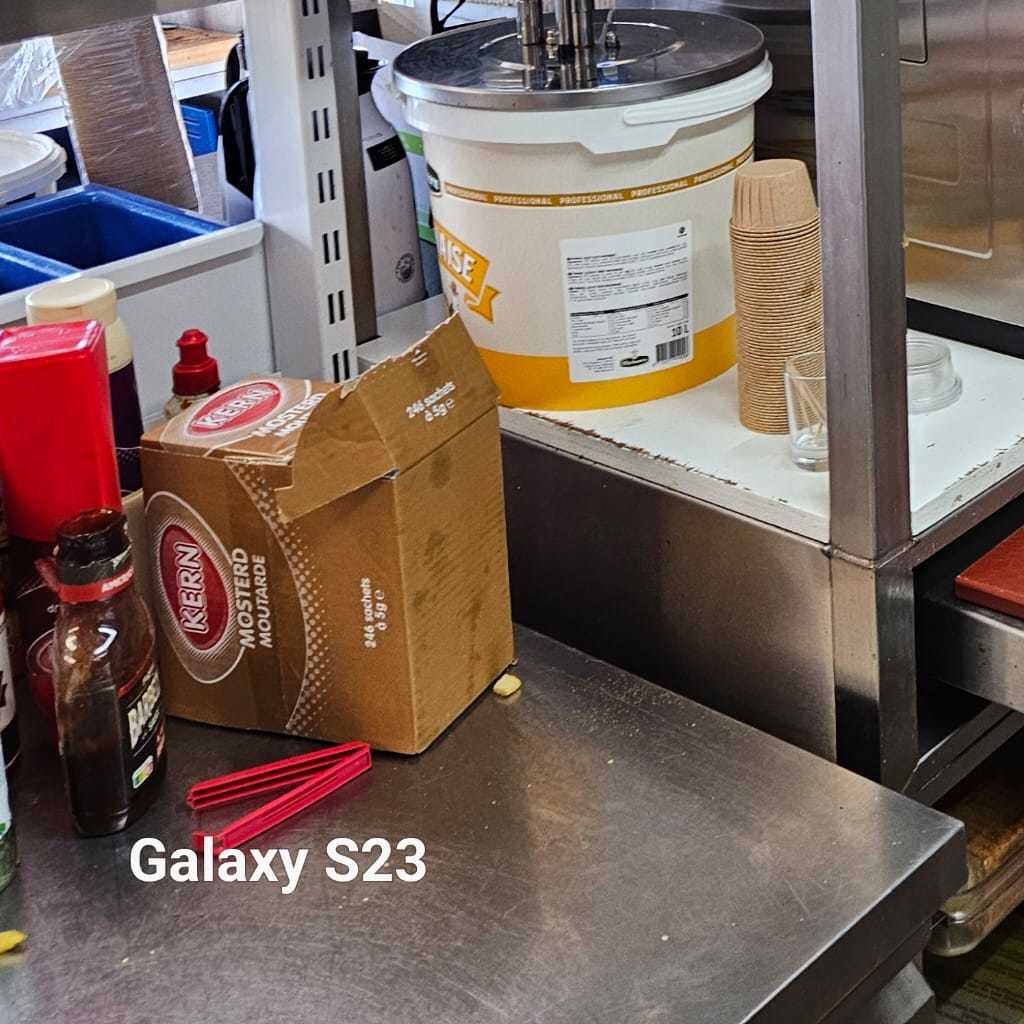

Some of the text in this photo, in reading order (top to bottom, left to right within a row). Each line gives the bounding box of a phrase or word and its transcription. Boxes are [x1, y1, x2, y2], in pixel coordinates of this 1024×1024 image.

[559, 192, 625, 205] PROFESSIONAL
[630, 178, 689, 198] PROFESSIONAL
[191, 387, 277, 427] KERN
[424, 381, 456, 407] sachets
[174, 541, 209, 634] KERN
[231, 547, 256, 649] MOSTERD
[252, 554, 273, 649] MOUTARDE
[360, 577, 377, 649] 246 sachets
